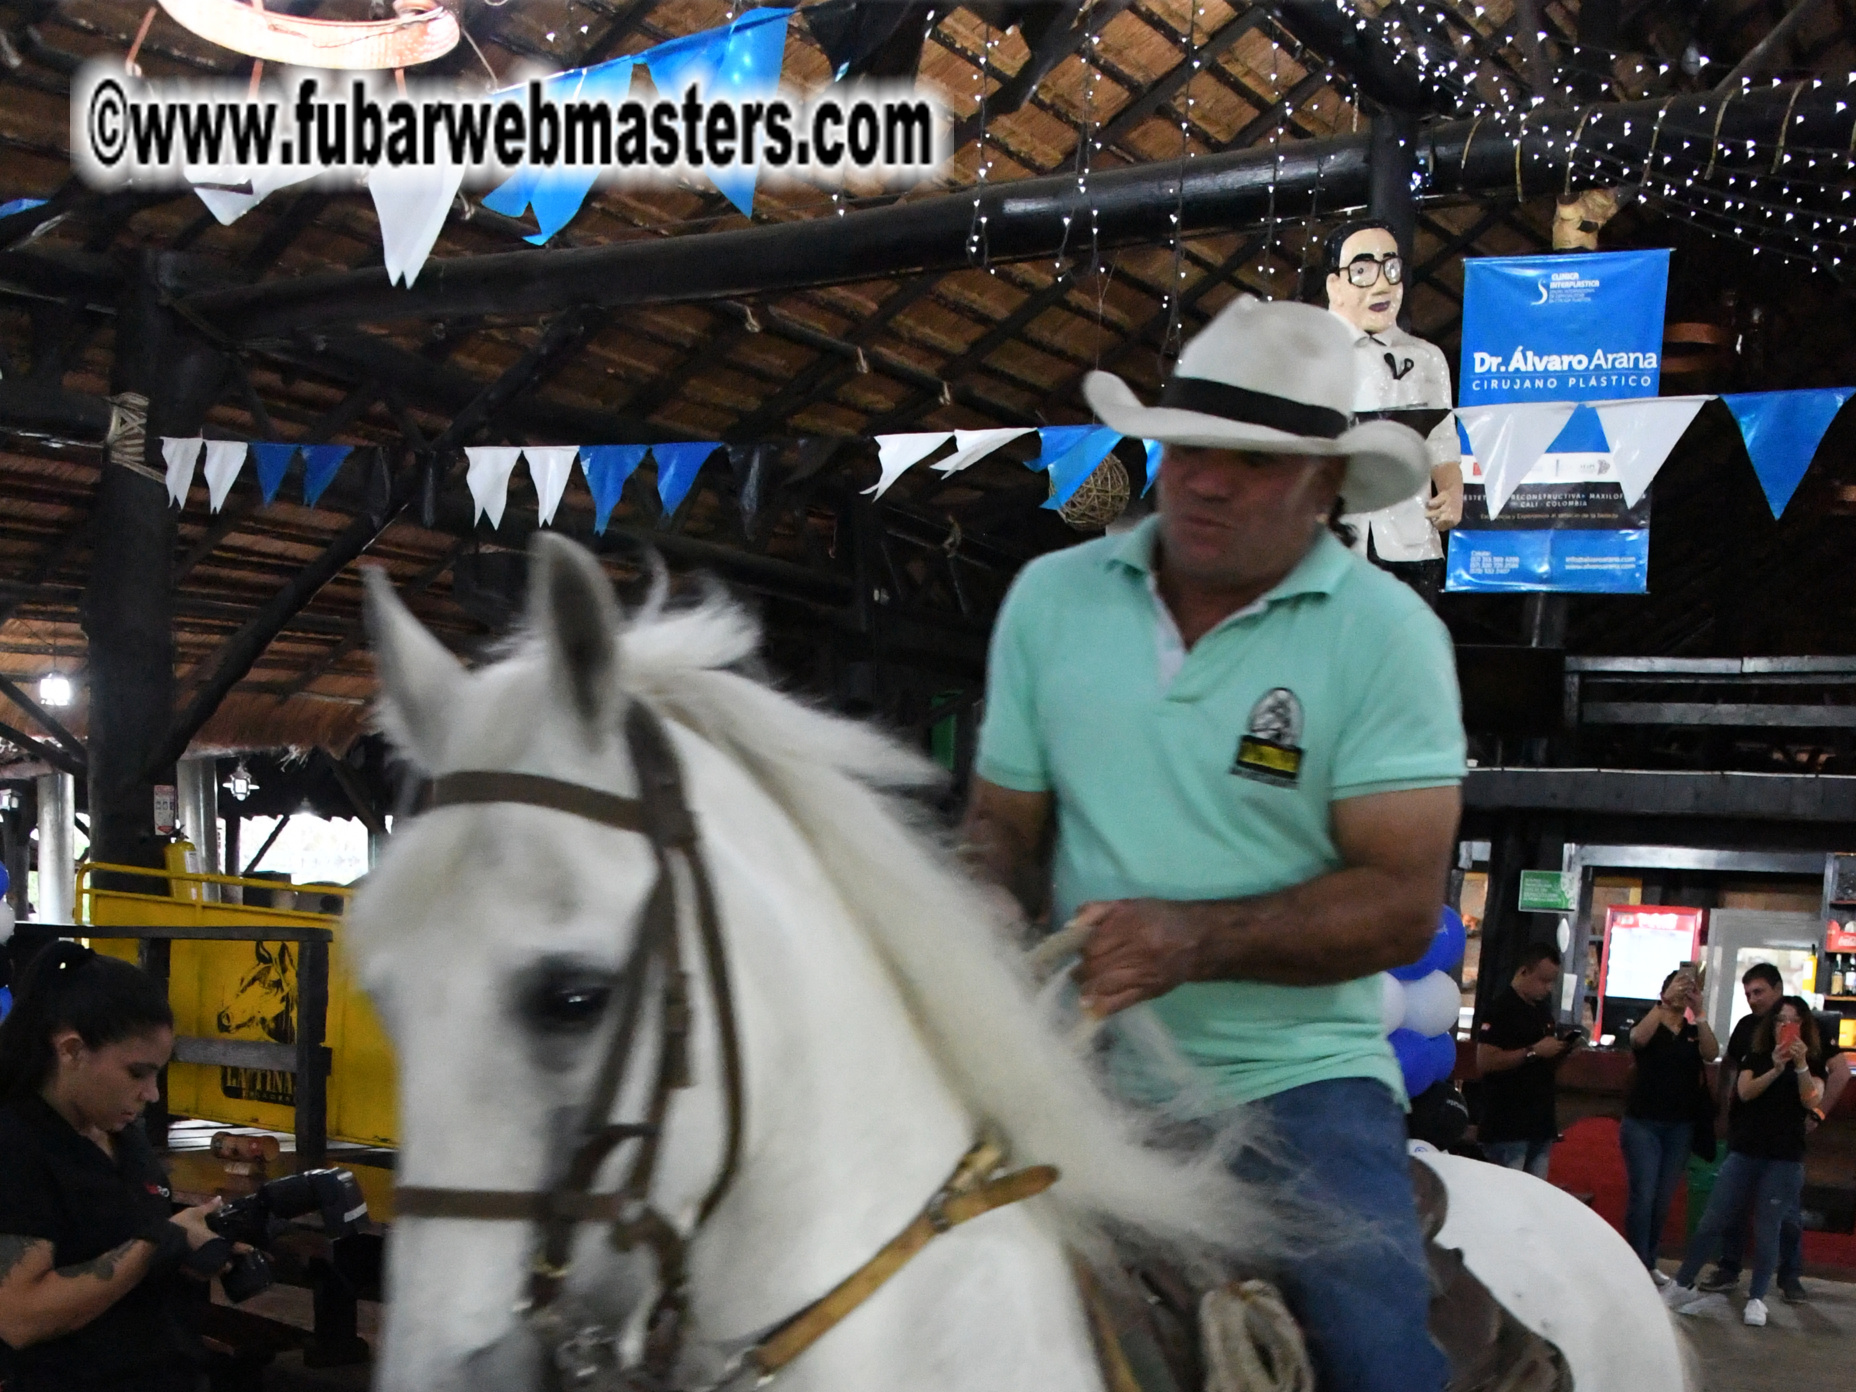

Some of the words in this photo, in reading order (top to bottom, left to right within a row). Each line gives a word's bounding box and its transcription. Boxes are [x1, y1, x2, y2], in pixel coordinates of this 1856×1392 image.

[1473, 352, 1506, 374] Dr.
[1507, 345, 1589, 372] Álvaro
[1589, 348, 1658, 370] Arana
[1472, 378, 1558, 391] CIRUJANO
[1568, 375, 1652, 389] PLÁSTICO
[1546, 500, 1588, 508] COLOMBIA
